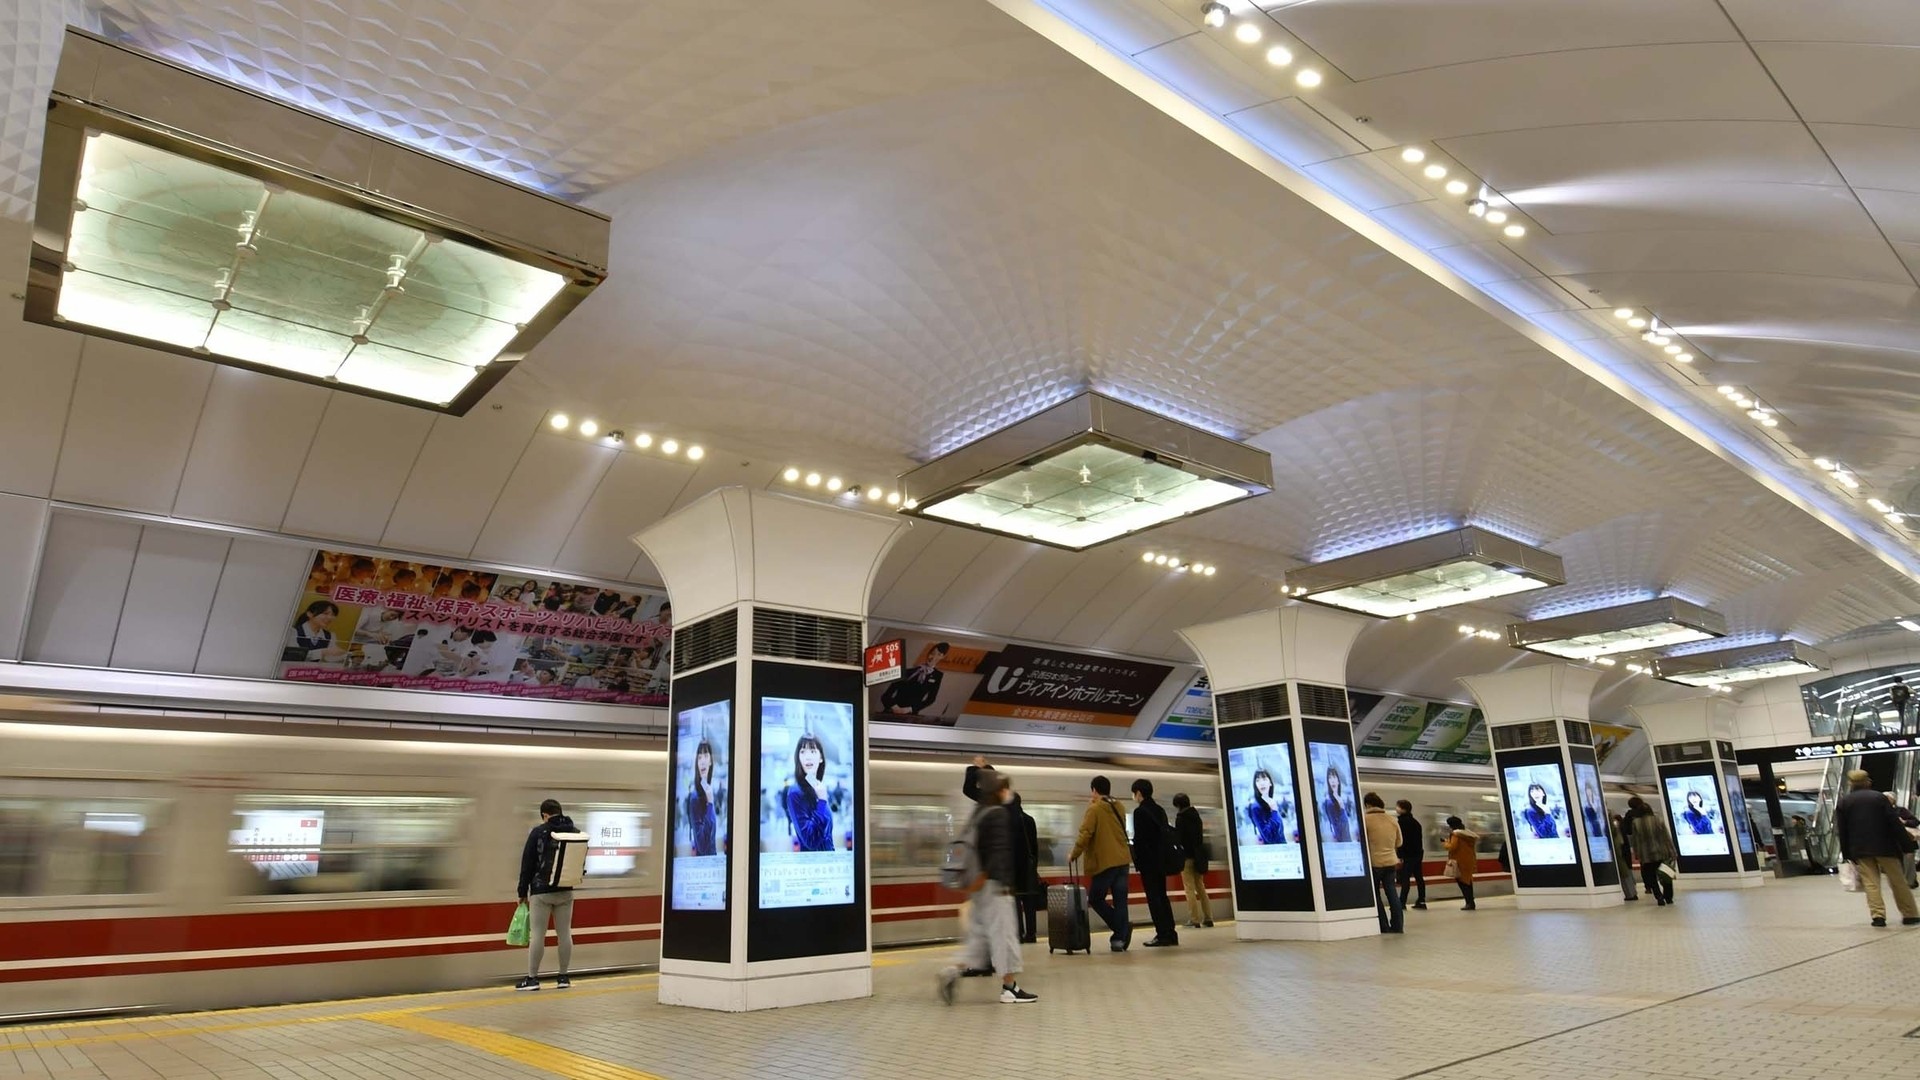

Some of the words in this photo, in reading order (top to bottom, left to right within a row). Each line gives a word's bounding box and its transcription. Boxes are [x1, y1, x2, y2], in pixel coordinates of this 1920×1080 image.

[885, 642, 899, 653] SOS
[1017, 680, 1144, 707] ヴィアインホテルチェーン
[601, 826, 622, 838] 梅田
